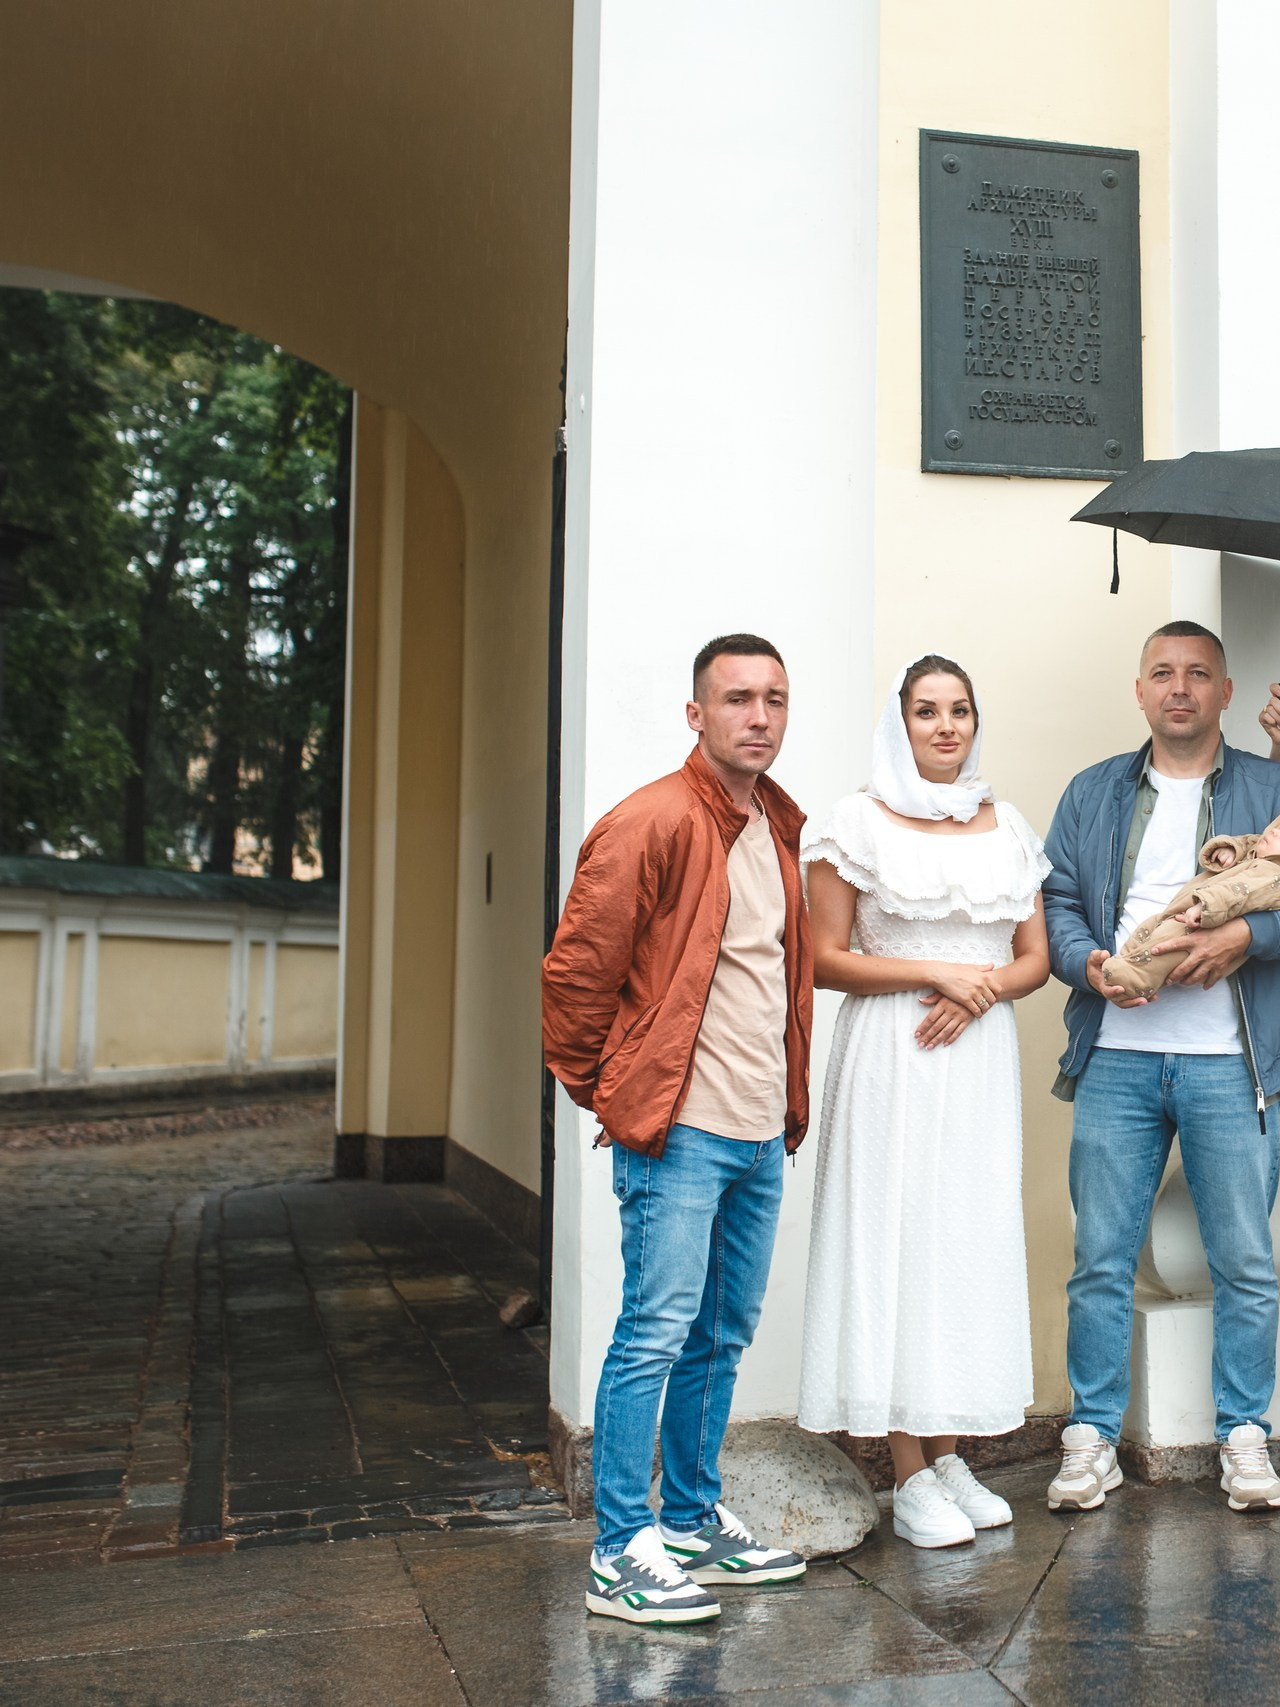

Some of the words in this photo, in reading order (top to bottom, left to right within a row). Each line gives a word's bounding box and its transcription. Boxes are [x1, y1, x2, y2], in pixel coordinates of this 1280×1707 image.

[981, 181, 1085, 206] ПАМЯТНИК
[966, 196, 1098, 222] АРХИТЕКТУРЫ
[1009, 218, 1054, 239] XVIII
[1010, 237, 1054, 251] ВЕКА
[963, 247, 1030, 268] ЗДАНИЕ
[1036, 255, 1100, 276] БЫВШЕЙ
[964, 265, 1101, 294] НАДВРАТНОЙ
[964, 285, 1101, 311] ЦЕРКВИ
[964, 302, 1101, 326] ПОСТРОЕНО
[964, 340, 1101, 365] АРХИТЕКТОР
[981, 389, 1087, 410] ОХРАНЯЕТСЯ
[968, 404, 1098, 427] ГОСУДАРСТВОМ
